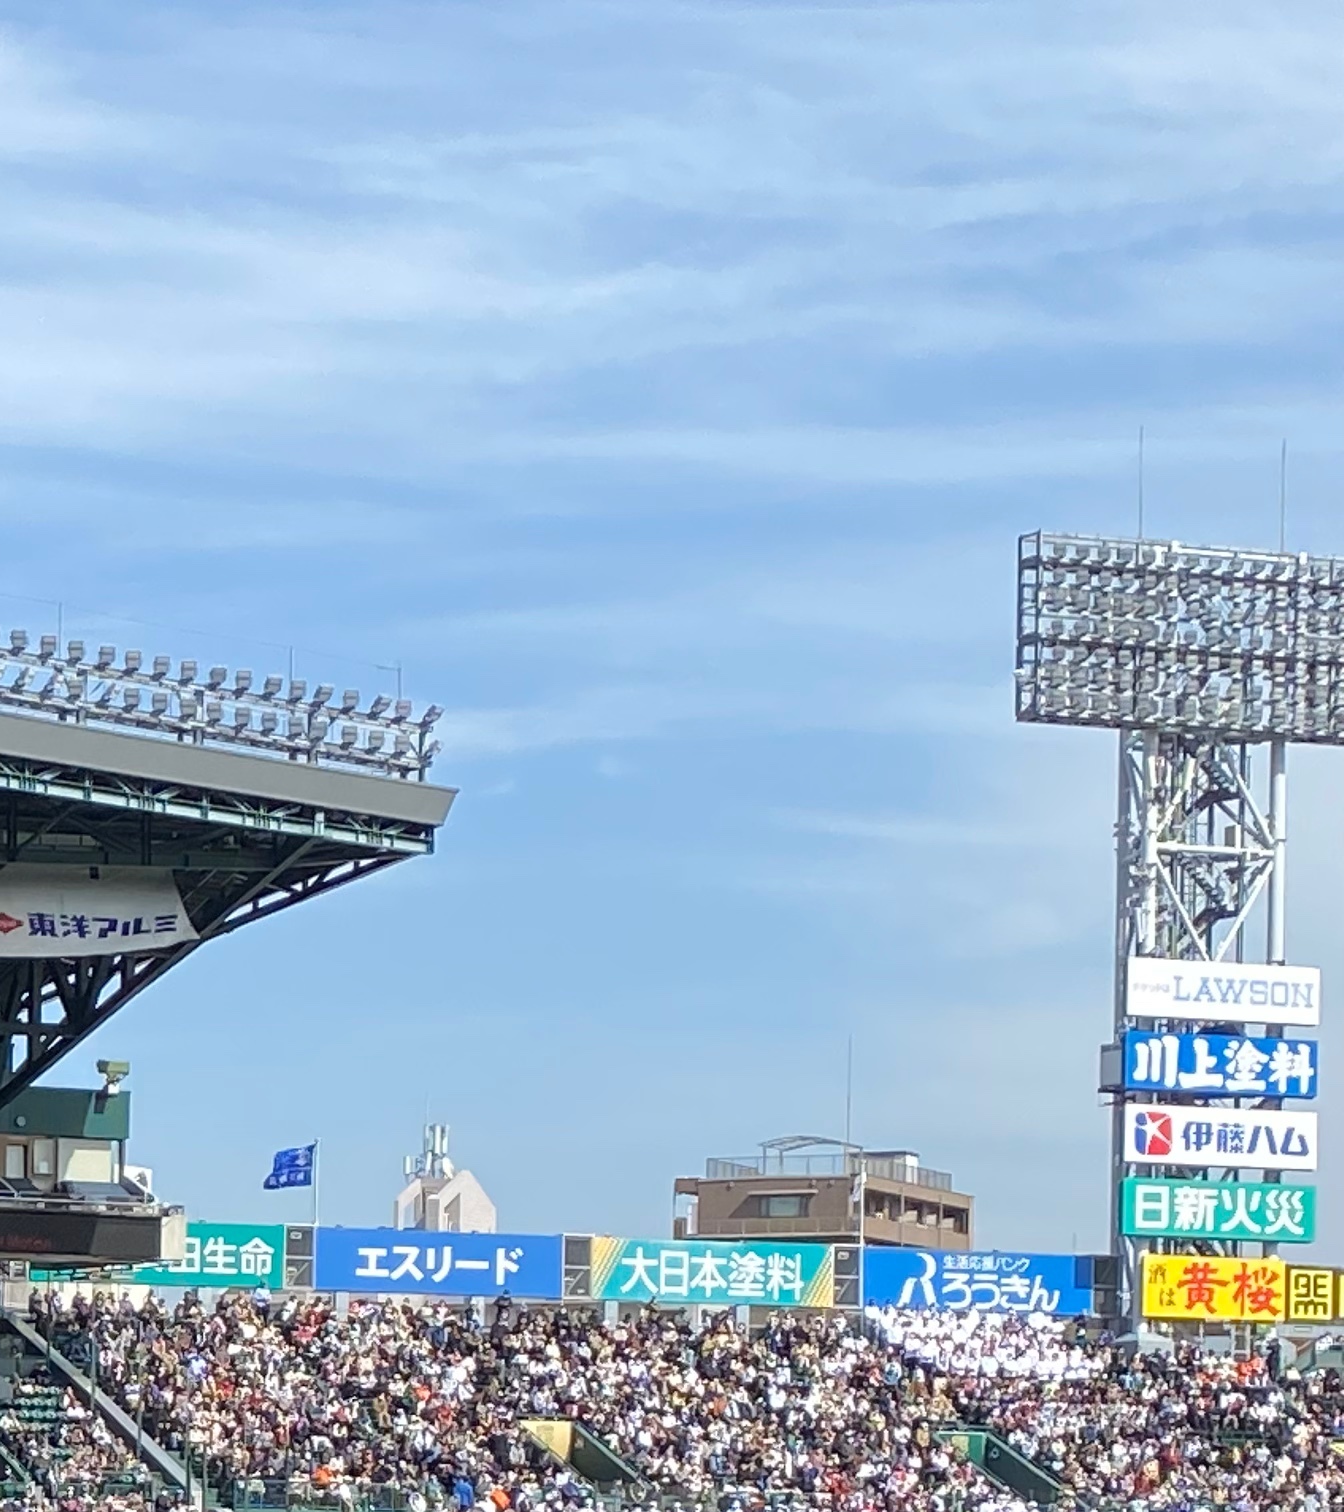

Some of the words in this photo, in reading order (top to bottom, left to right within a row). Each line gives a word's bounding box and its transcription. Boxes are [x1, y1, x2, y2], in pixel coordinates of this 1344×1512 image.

[27, 911, 179, 938] 東洋アルミ
[1173, 975, 1314, 1008] LAWSON
[1132, 1035, 1315, 1094] 川上塗料
[1180, 1120, 1310, 1157] 伊藤ハム
[1134, 1184, 1305, 1236] 日新火災
[355, 1245, 524, 1286] エスリード
[620, 1247, 804, 1300] 大日本塗料
[942, 1272, 1060, 1312] ろうきん
[1176, 1261, 1284, 1317] 黄桜
